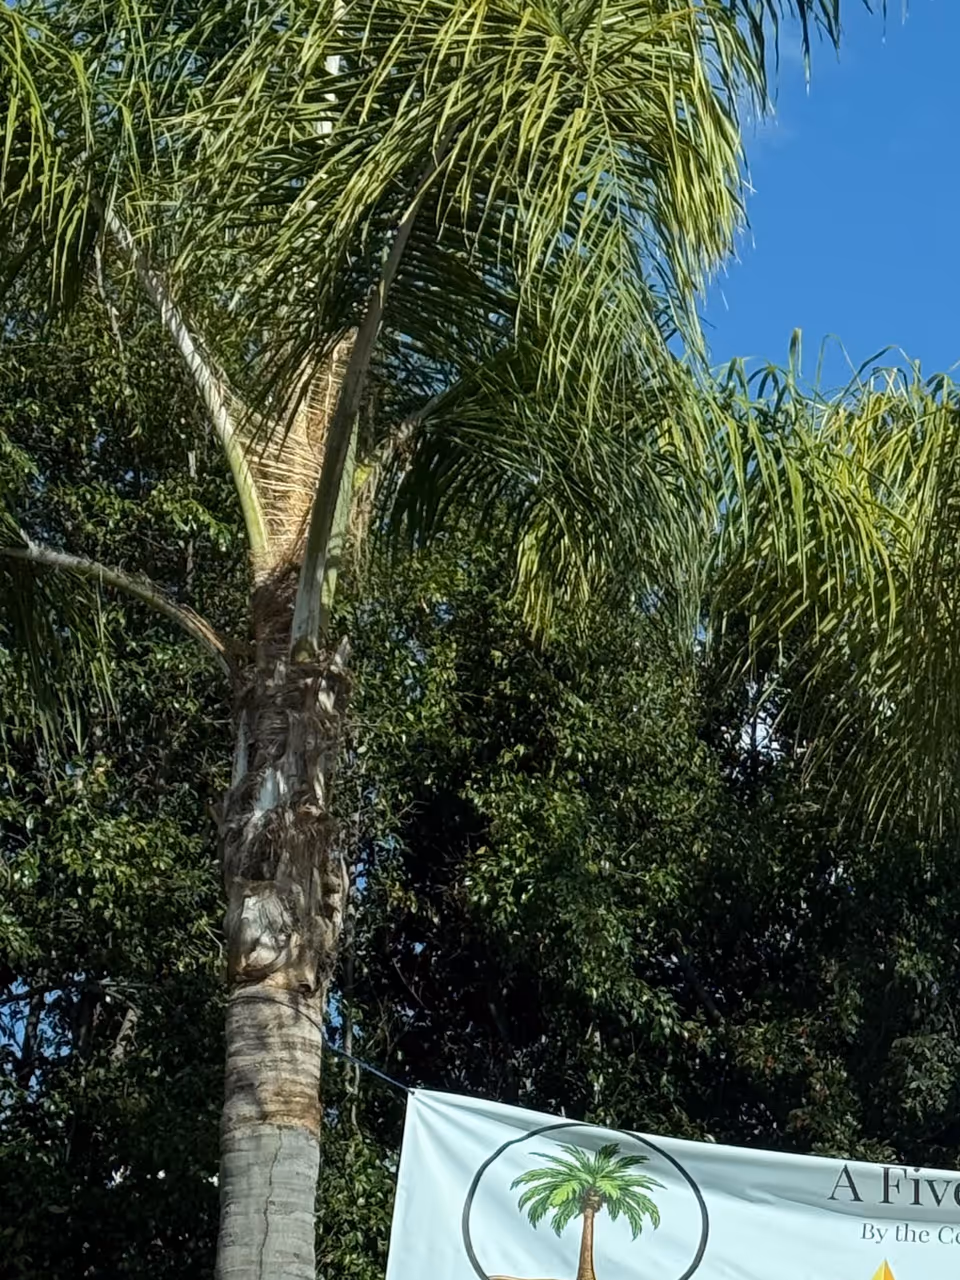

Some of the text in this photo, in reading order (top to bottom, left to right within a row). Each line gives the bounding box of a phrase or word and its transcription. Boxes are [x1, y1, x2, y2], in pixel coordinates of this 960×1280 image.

[828, 1164, 864, 1202] A
[861, 1222, 889, 1244] By
[895, 1224, 930, 1244] the
